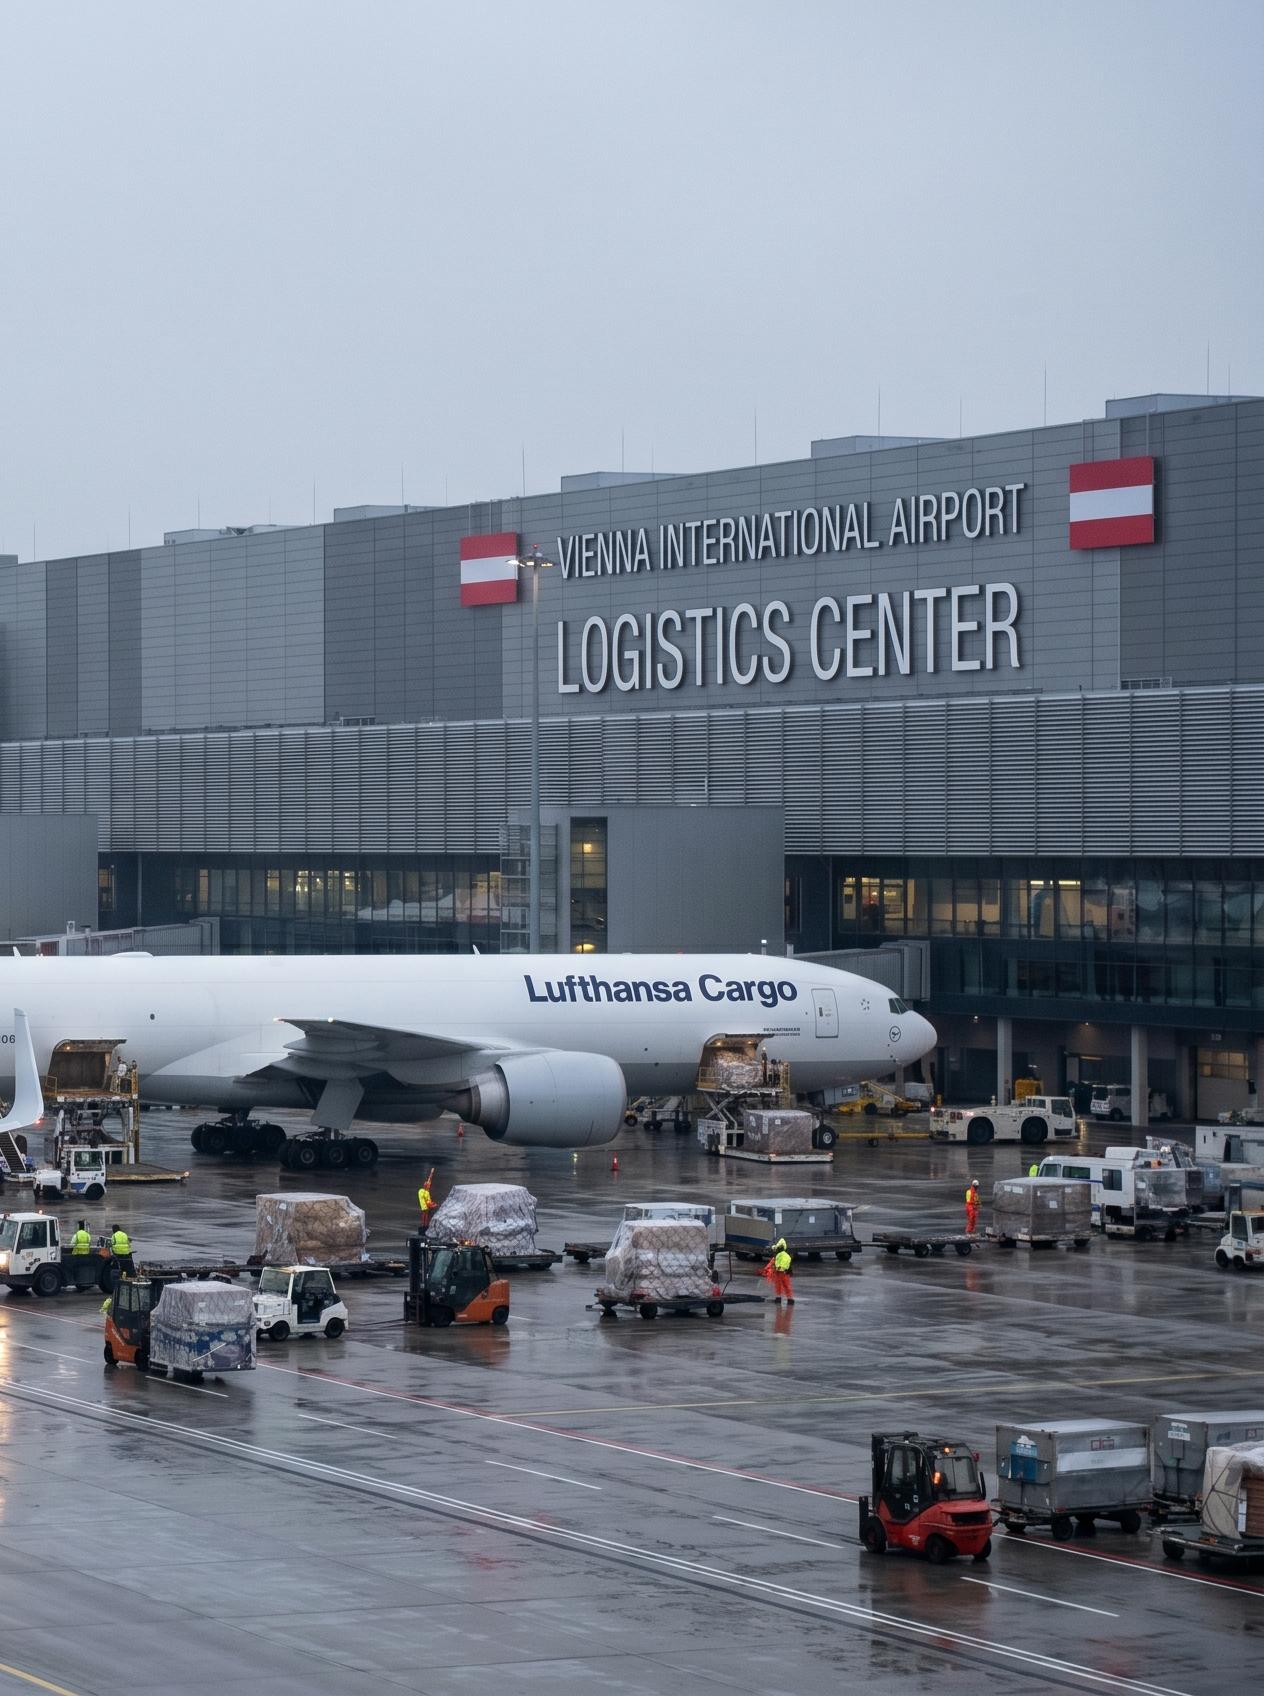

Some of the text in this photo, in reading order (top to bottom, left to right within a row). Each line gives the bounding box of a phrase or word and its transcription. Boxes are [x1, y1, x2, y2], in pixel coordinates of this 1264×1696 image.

[557, 483, 1025, 579] VIENNA INTERNATIONAL AIRPORT
[557, 582, 1020, 694] LOGISTICS CENTER
[523, 973, 798, 1008] Lufthansa Cargo
